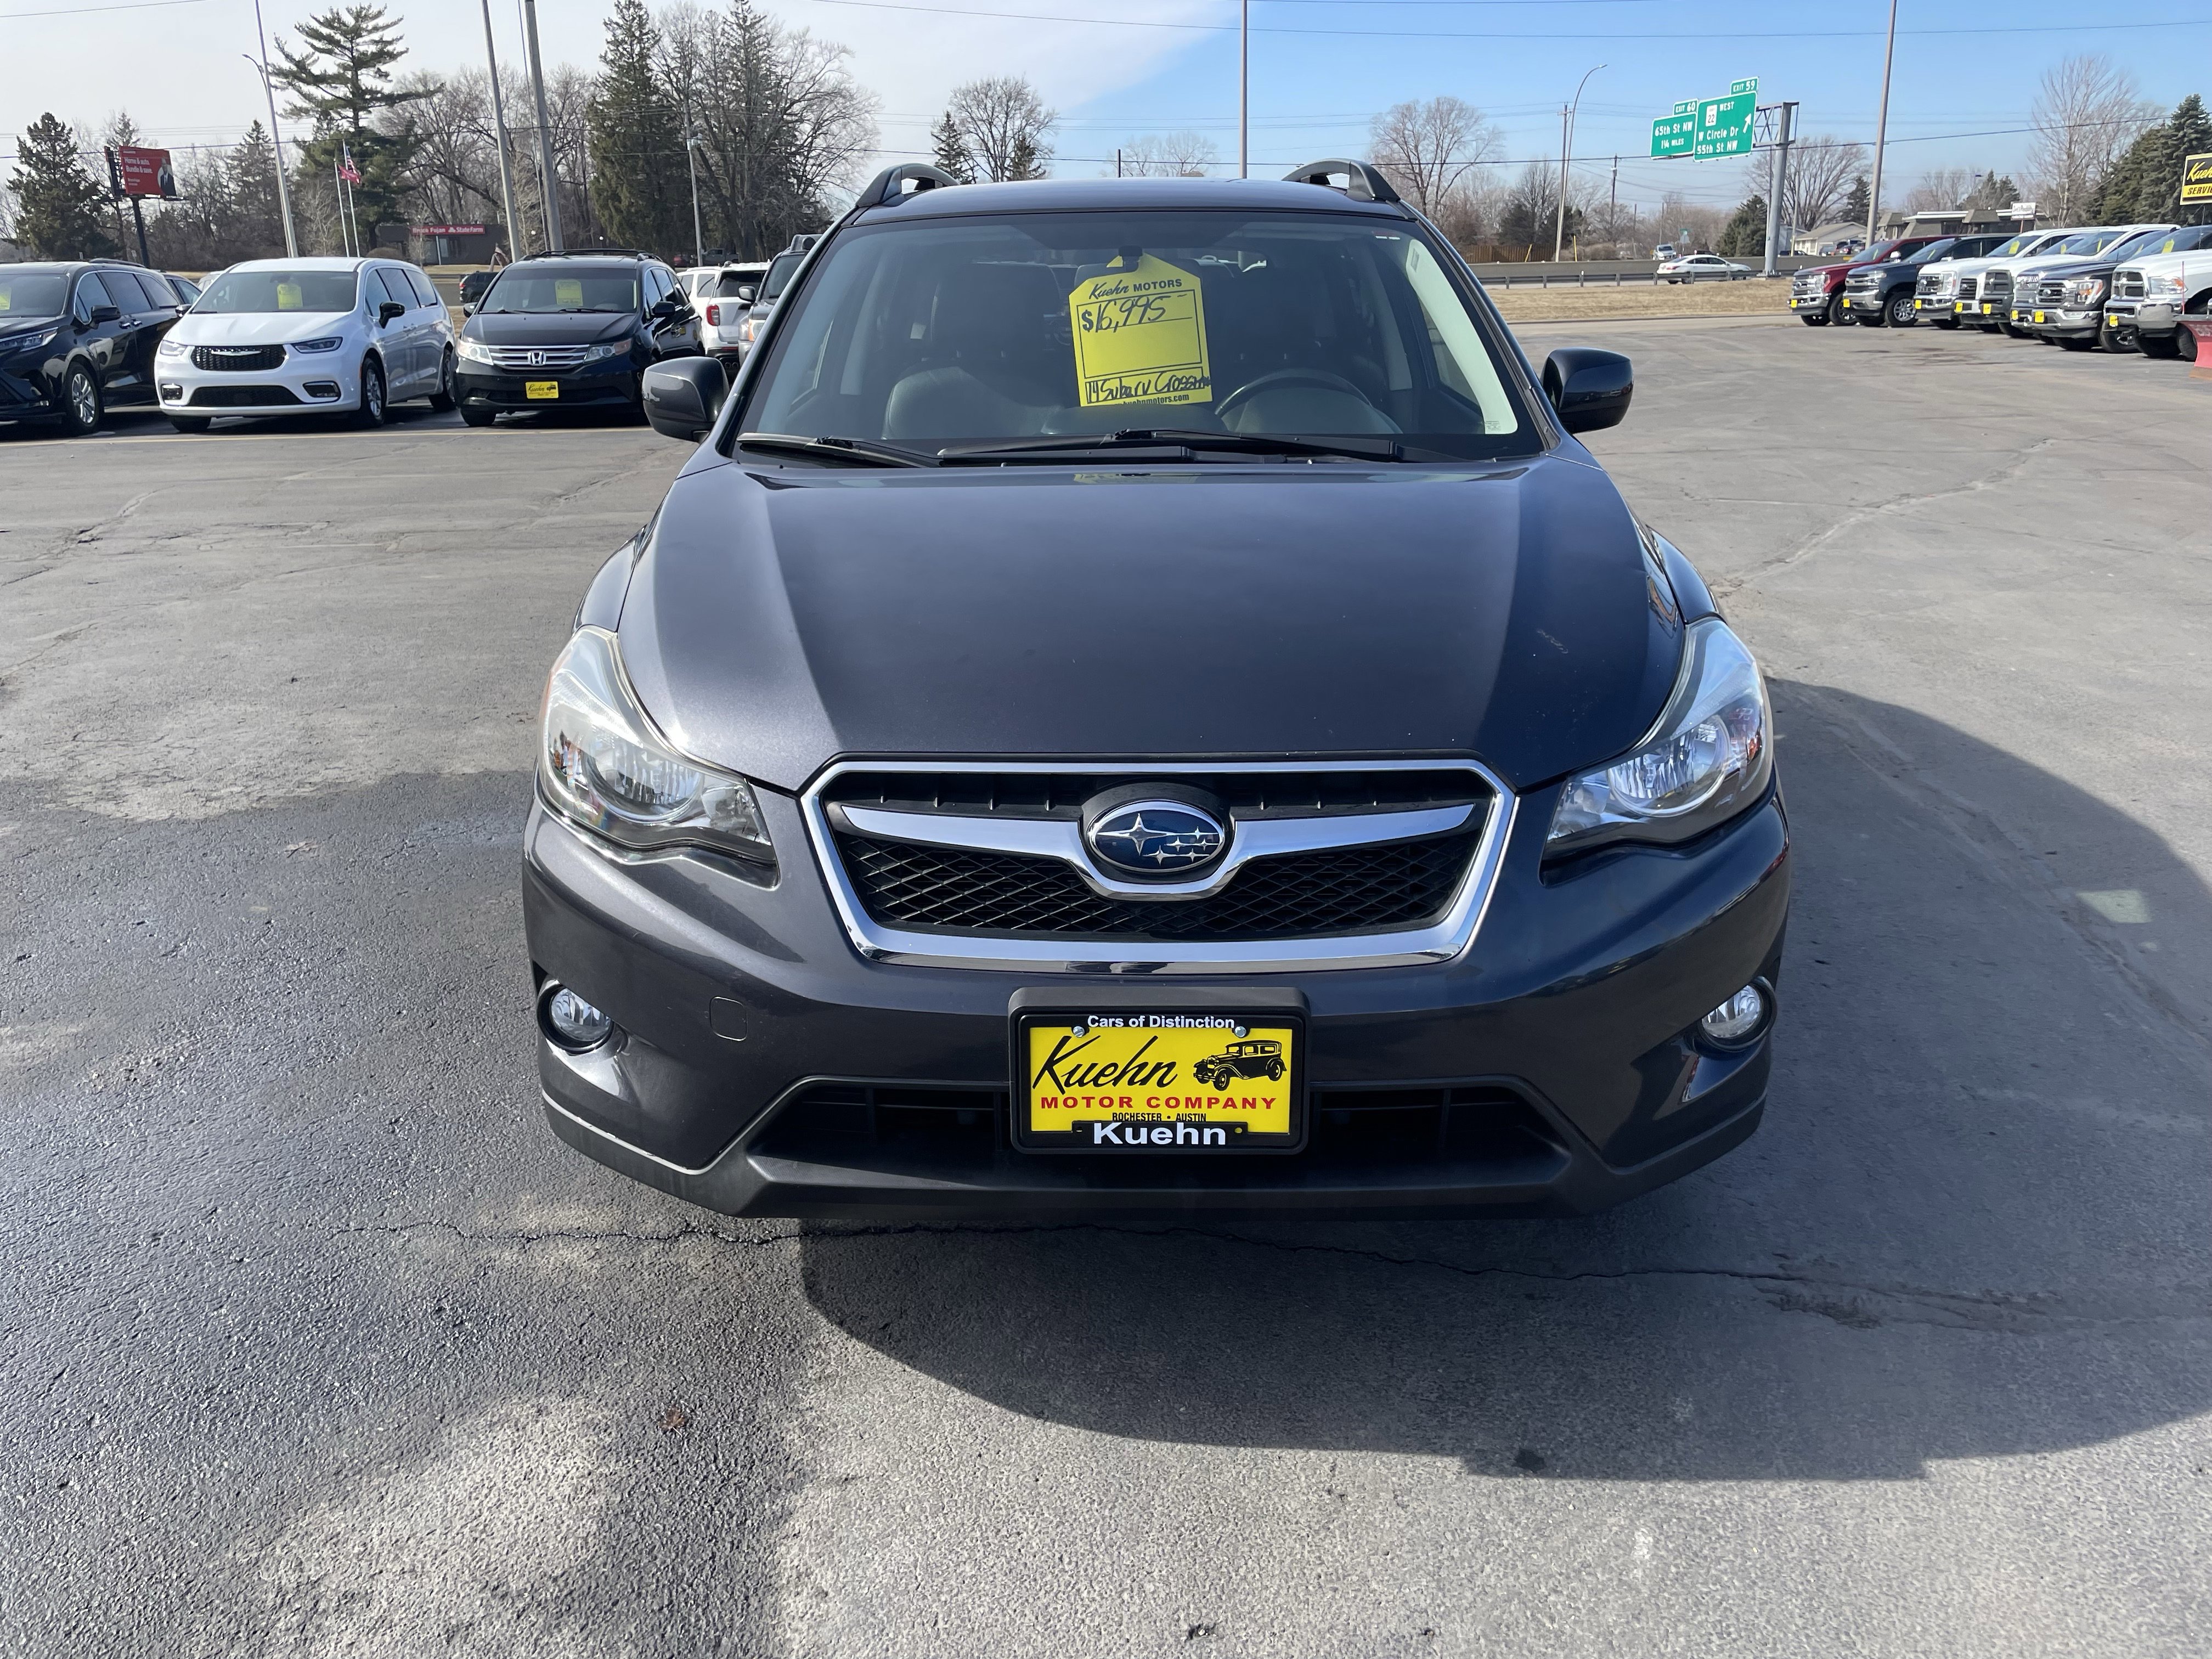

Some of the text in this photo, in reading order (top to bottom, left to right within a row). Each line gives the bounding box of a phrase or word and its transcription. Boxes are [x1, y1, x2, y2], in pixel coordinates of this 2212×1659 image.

[1733, 80, 1755, 92] EXIT 59
[1675, 101, 1696, 113] EXIT 60
[1719, 101, 1735, 111] WEST
[1707, 114, 1715, 123] 22
[1655, 121, 1693, 136] 65th St NW
[1698, 126, 1739, 141] W Circle Dr
[1697, 140, 1738, 154] 55th St NW
[1089, 279, 1182, 300] Kuehn MOTORS
[1087, 1015, 1234, 1029] Cars of Distinction
[1032, 1035, 1178, 1095] Kuehn
[1041, 1097, 1277, 1109] MOTOR COMPANY
[1112, 1112, 1206, 1122] ROCHESTER AUSTIN
[1093, 1121, 1226, 1145] Kuehn
